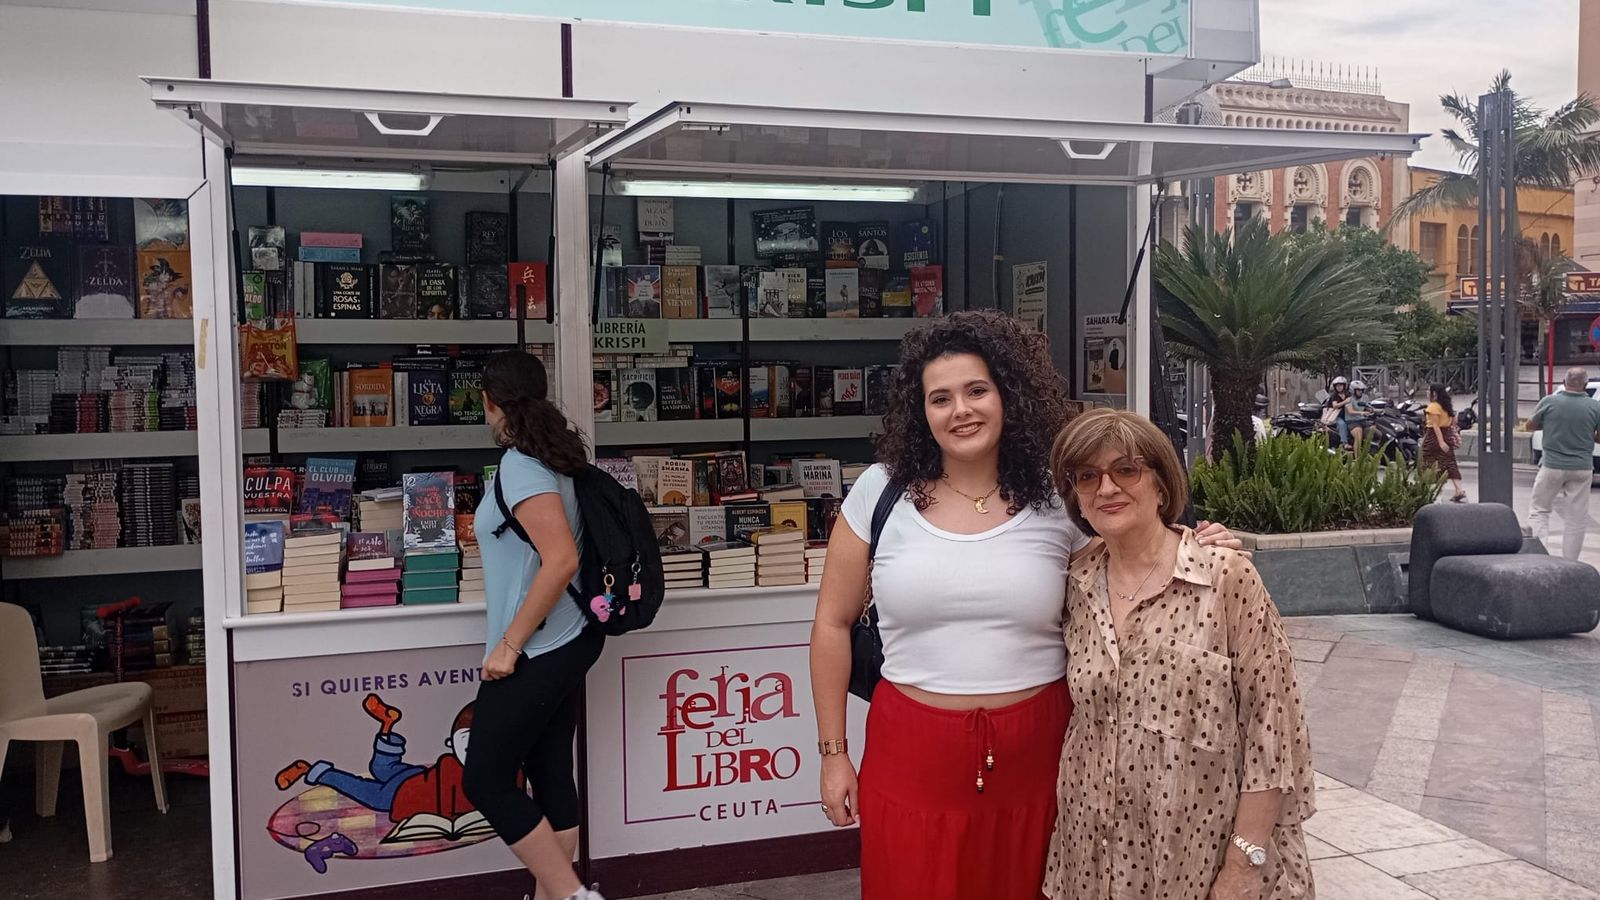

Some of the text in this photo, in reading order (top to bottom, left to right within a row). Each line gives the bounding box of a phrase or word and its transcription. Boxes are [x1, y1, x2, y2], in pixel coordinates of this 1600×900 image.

[832, 229, 848, 238] LOS
[858, 229, 887, 237] SANTOS
[19, 246, 52, 260] ZELDA
[88, 276, 124, 287] ZELDA
[333, 295, 358, 303] ROSAS
[1086, 316, 1110, 326] SAHARA
[594, 320, 646, 334] LIBRERÍA
[594, 336, 646, 348] KRISPI
[451, 372, 482, 380] STEPHEN
[413, 383, 443, 395] LISTA
[454, 379, 482, 389] KING
[414, 405, 443, 417] NEGRA
[309, 465, 318, 473] EL
[311, 473, 352, 482] OLVIDO
[803, 470, 832, 480] MARINA
[245, 476, 291, 491] CULPA
[244, 491, 290, 499] VUESTRA
[415, 495, 441, 505] NACE
[738, 516, 760, 524] NUNCA
[292, 667, 483, 697] SI QUIERES AVENT
[659, 665, 800, 732] feria
[657, 730, 801, 793] LIBRO
[699, 798, 778, 821] CEUTA
